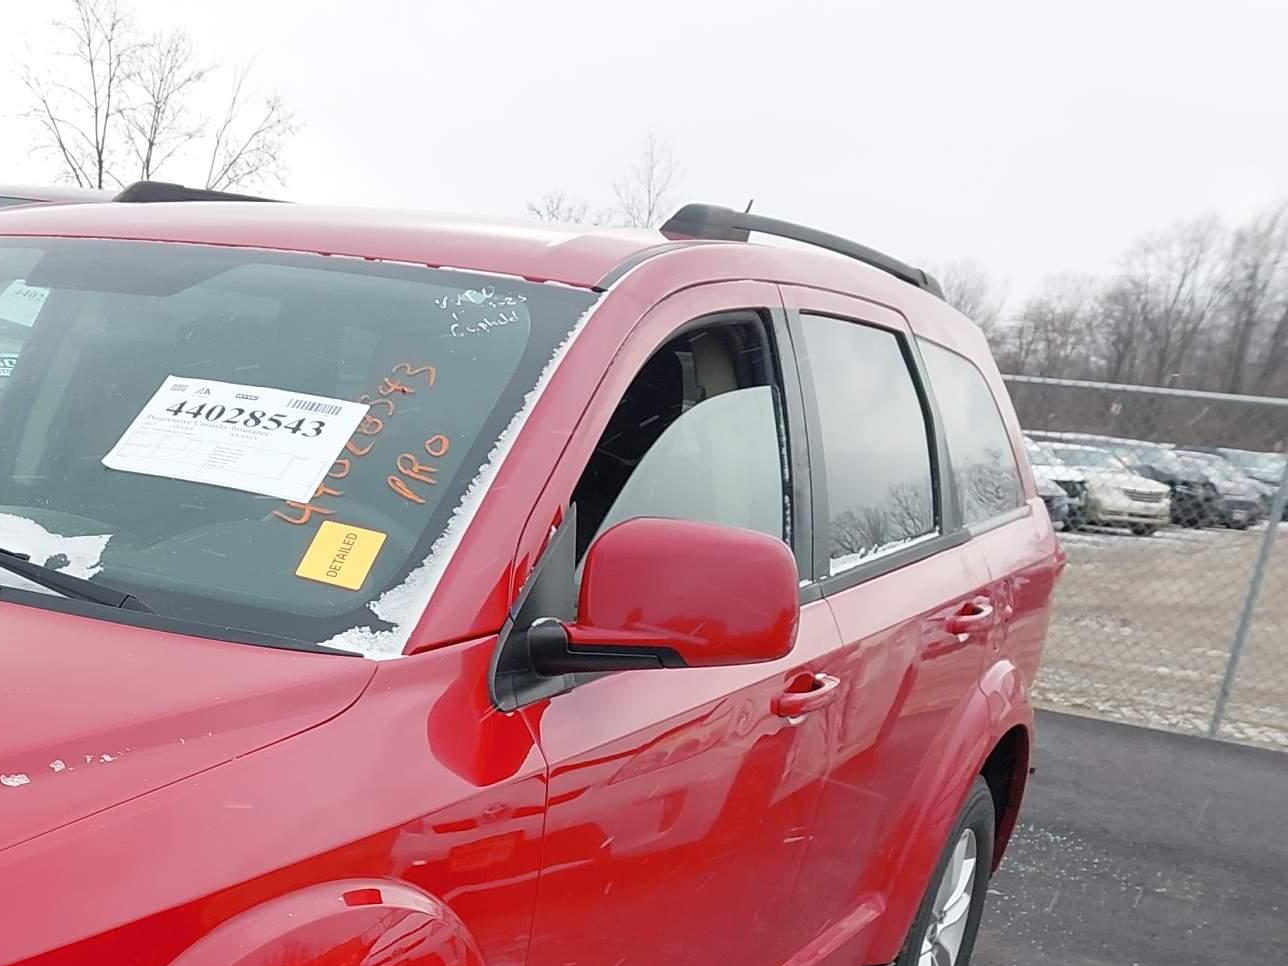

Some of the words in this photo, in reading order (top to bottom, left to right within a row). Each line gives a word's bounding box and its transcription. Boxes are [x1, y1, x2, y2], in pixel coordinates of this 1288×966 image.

[166, 400, 326, 438] 44028543
[387, 434, 450, 504] PRO
[326, 532, 358, 578] DETAILED
